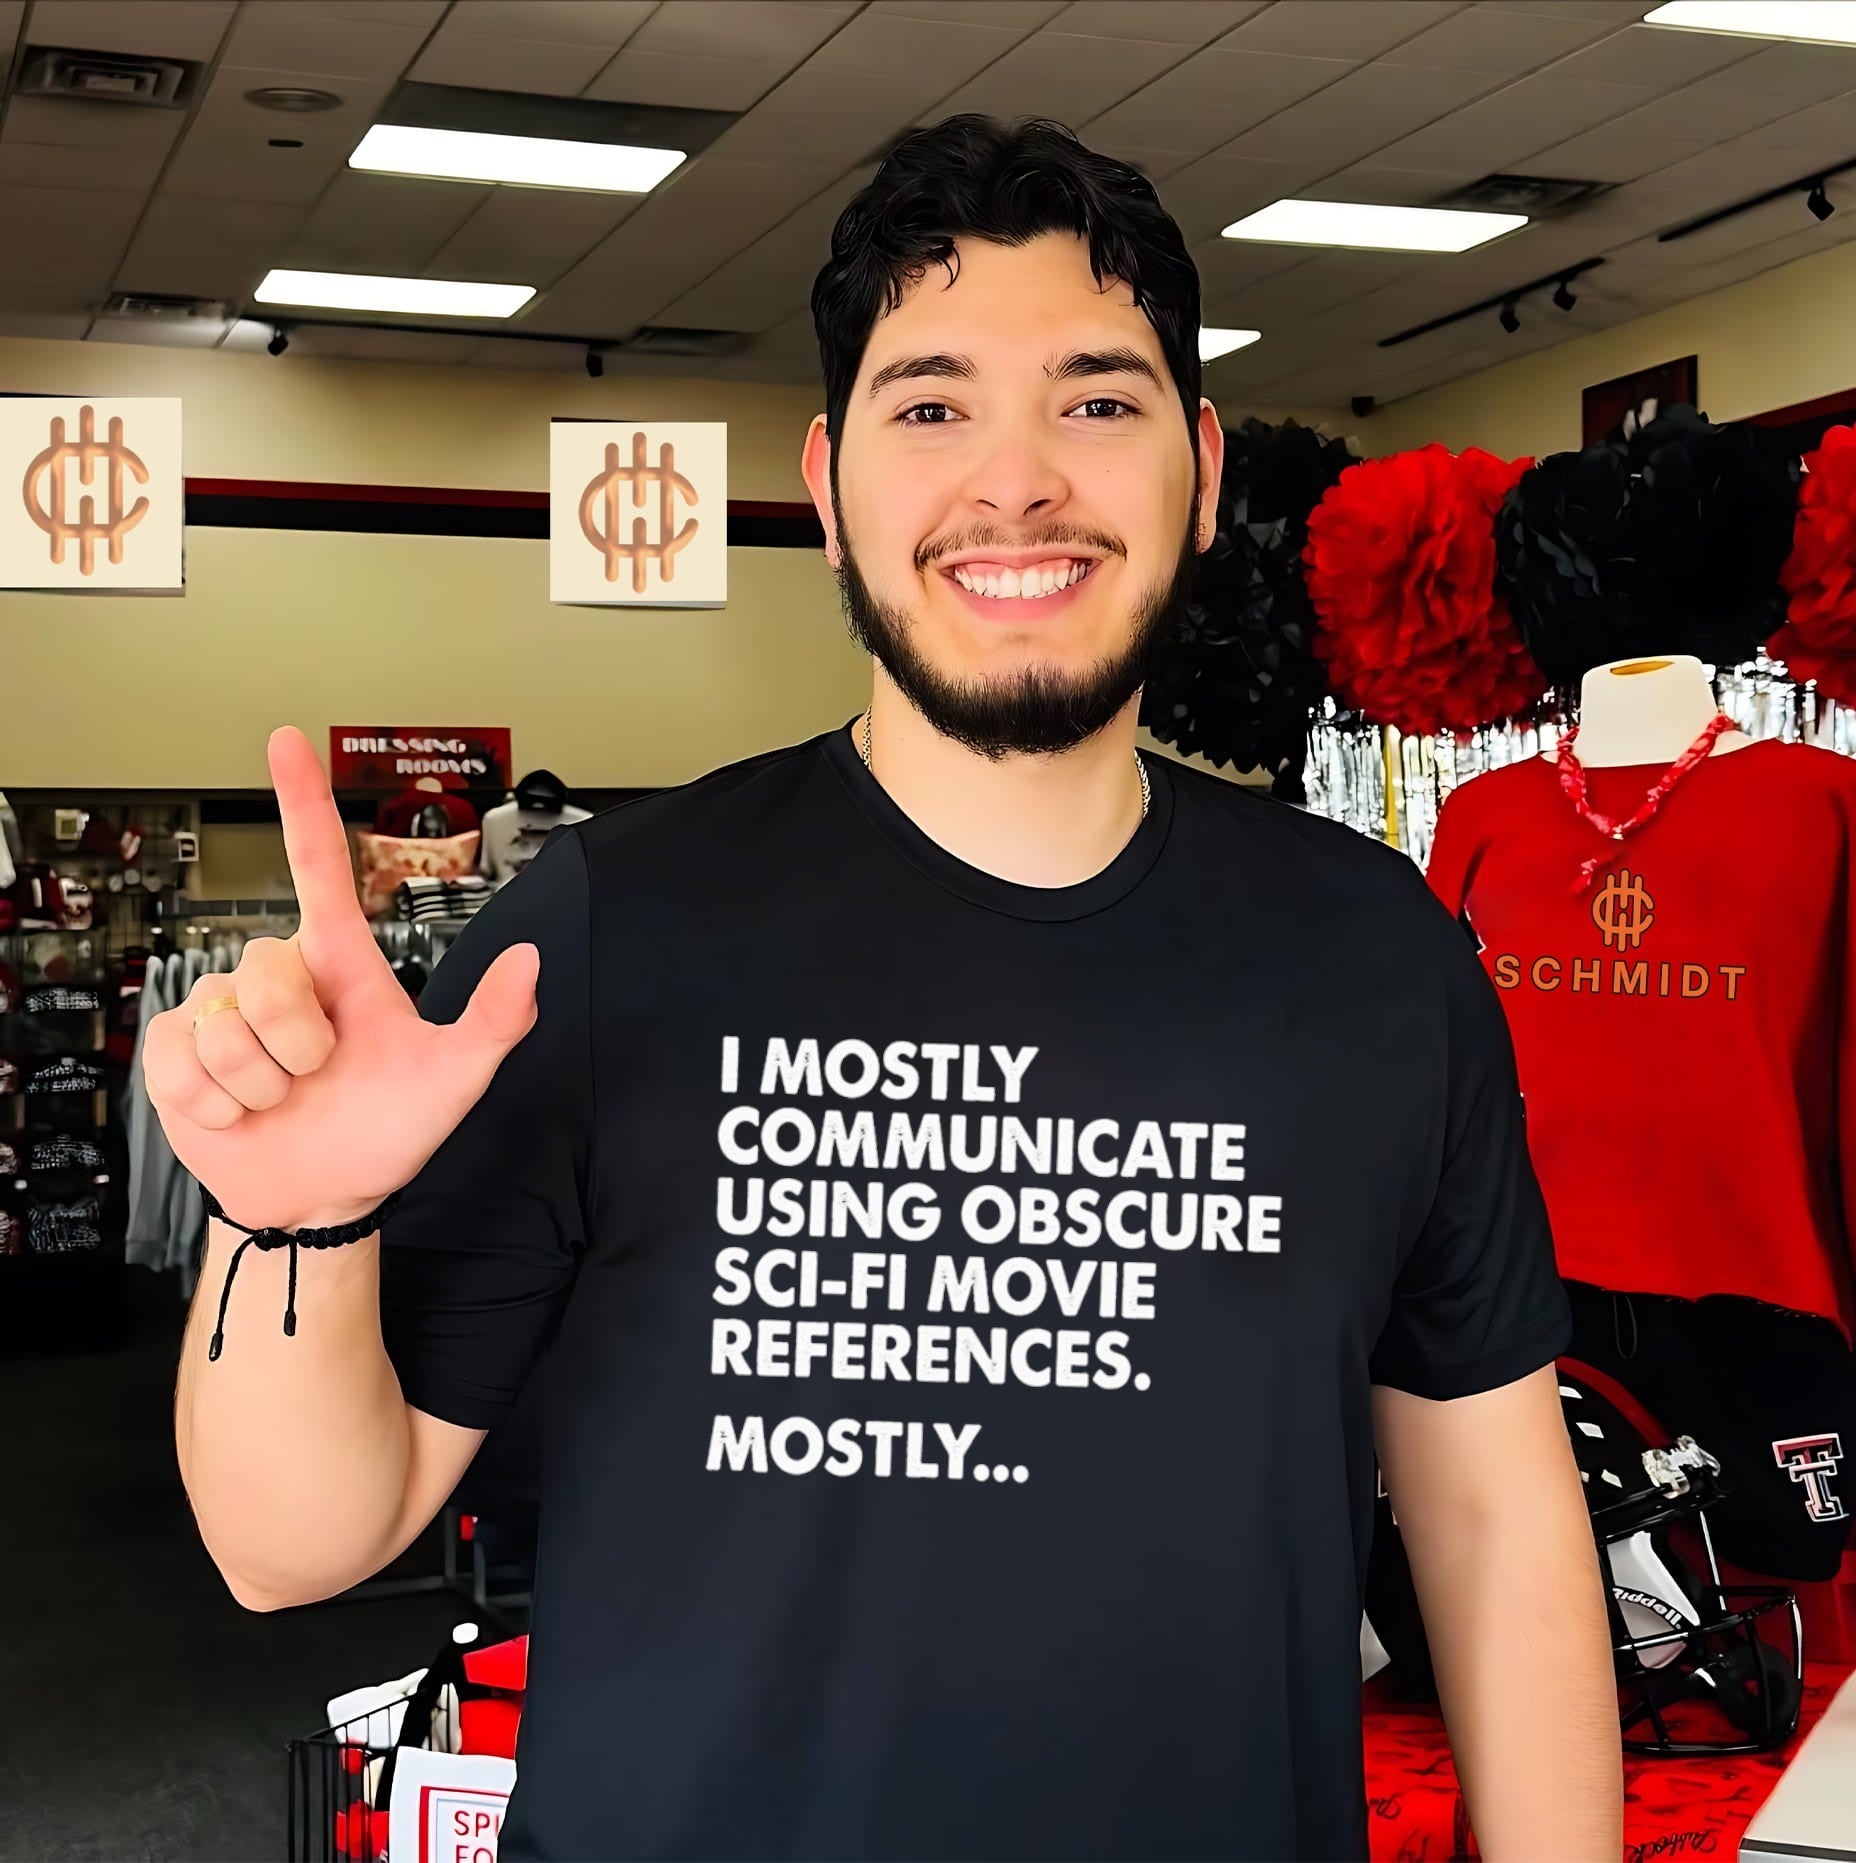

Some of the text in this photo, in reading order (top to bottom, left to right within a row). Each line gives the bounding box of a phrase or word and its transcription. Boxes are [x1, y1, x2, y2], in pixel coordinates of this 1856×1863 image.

[342, 737, 467, 754] DRESSING
[396, 758, 487, 775] ROOMS
[1494, 954, 1747, 1001] SCHMIDT
[721, 1035, 1040, 1104] I MOSTLY
[717, 1105, 1247, 1182] COMMUNICATE
[716, 1176, 1283, 1254] USING OBSCURE
[712, 1246, 1157, 1320] SCI-FI MOVIE
[710, 1318, 1152, 1392] REFERENCES.
[705, 1414, 1030, 1484] MOSTLY...
